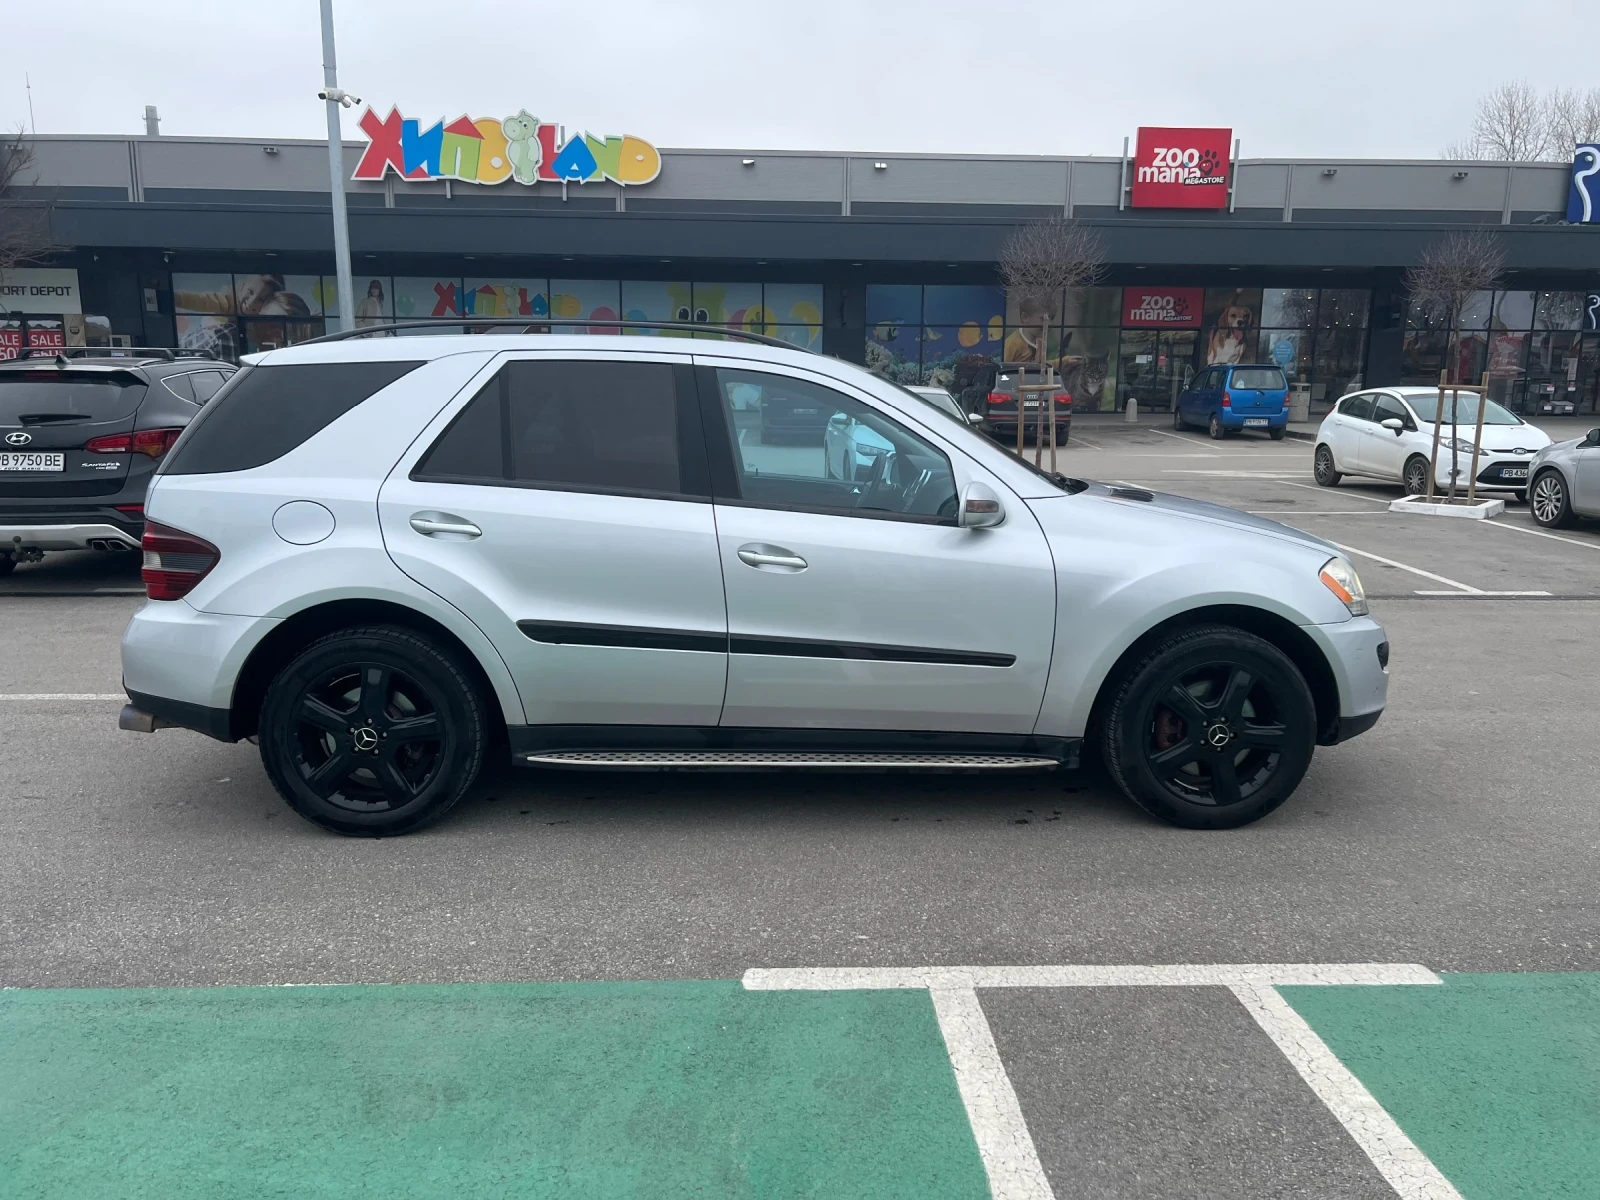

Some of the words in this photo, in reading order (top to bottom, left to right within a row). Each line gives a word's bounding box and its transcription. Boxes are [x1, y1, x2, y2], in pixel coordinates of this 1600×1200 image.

[1137, 166, 1201, 183] mania
[1184, 176, 1225, 185] MEGASTORE
[30, 286, 72, 296] DEPOT
[1130, 308, 1176, 320] mania
[30, 334, 62, 346] SALE
[0, 454, 9, 466] B
[12, 454, 42, 466] 9750
[44, 454, 61, 467] BE
